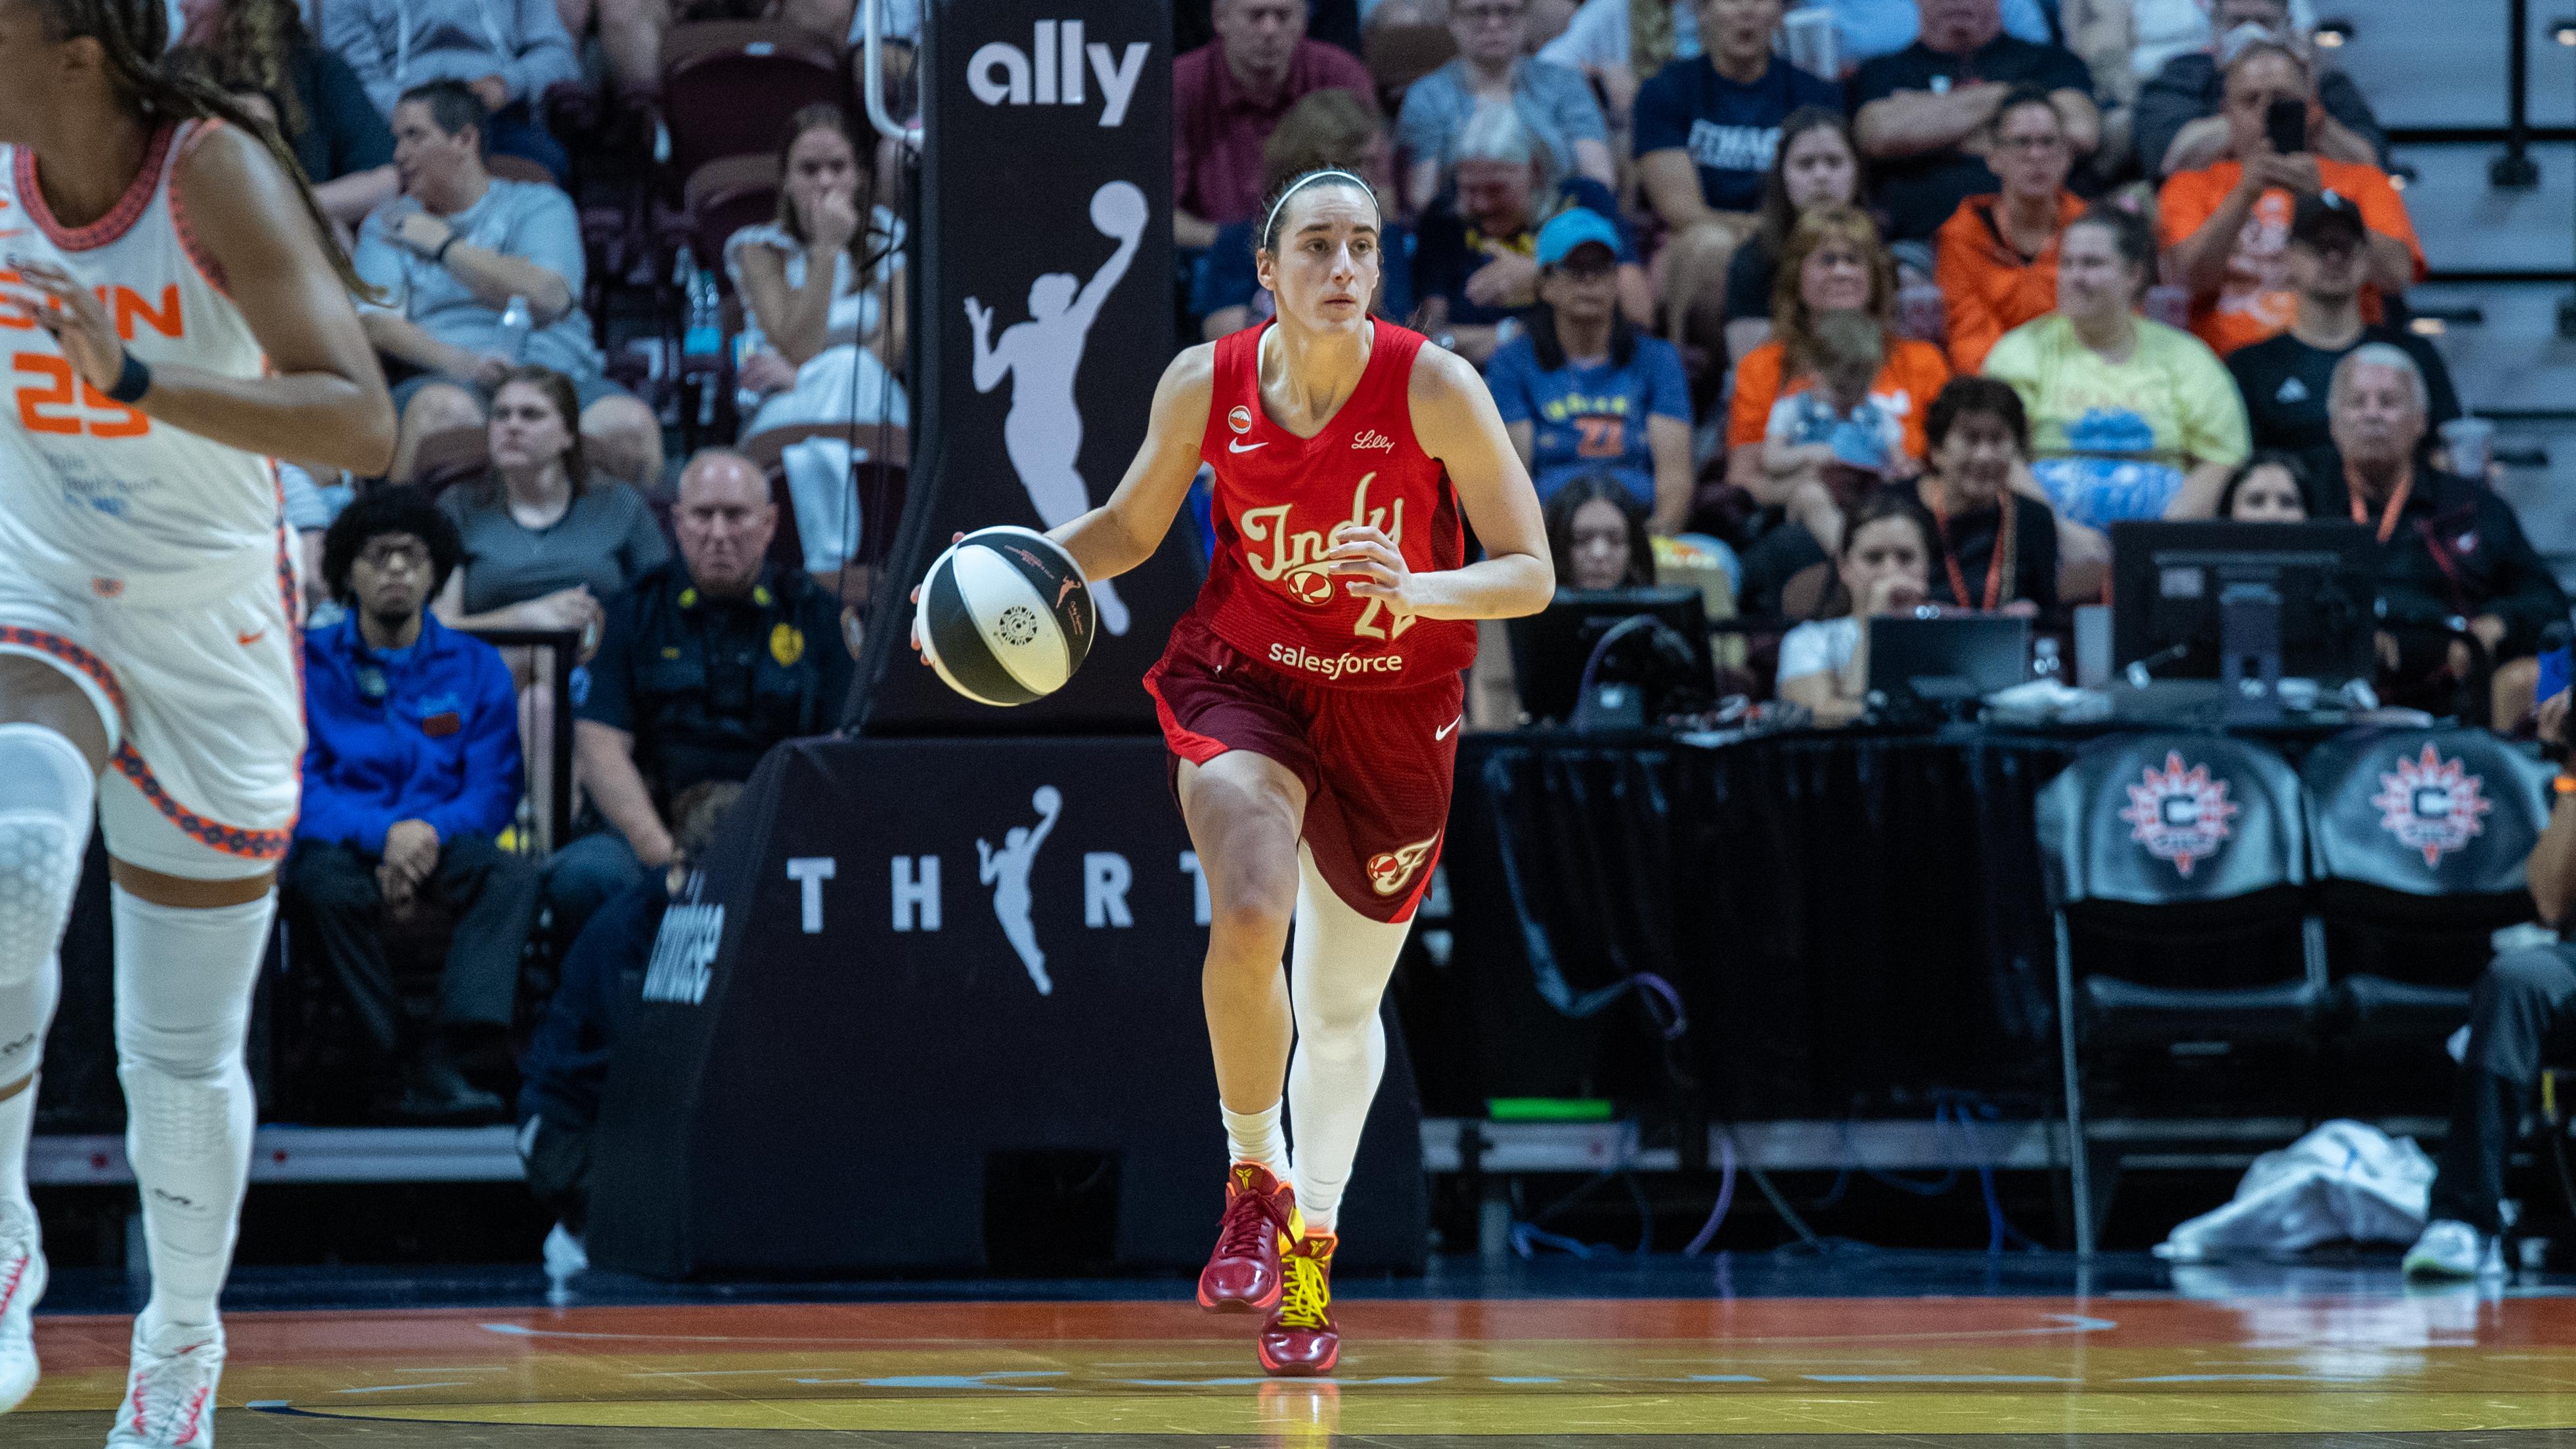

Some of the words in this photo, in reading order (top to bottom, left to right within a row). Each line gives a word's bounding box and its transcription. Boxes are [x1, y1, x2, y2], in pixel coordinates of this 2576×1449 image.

[966, 18, 1151, 127] ally
[1351, 429, 1395, 455] Lilly
[1268, 642, 1402, 680] salesforce
